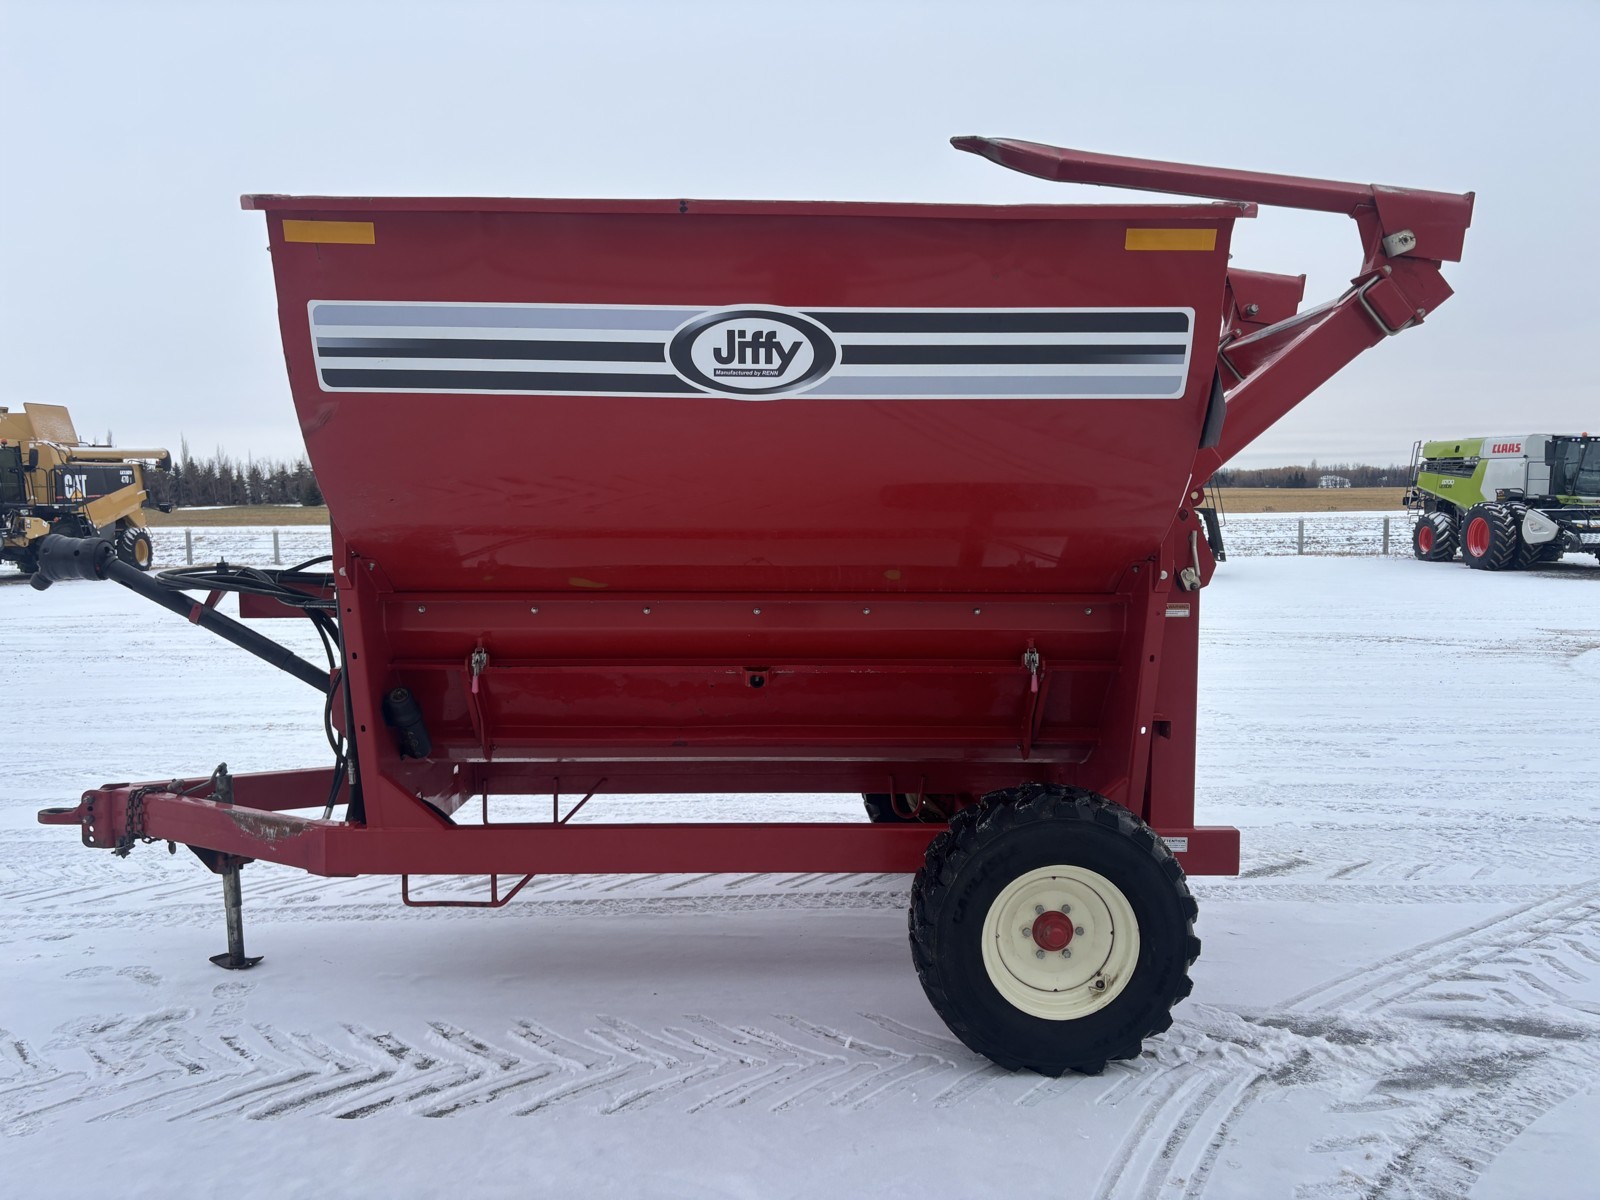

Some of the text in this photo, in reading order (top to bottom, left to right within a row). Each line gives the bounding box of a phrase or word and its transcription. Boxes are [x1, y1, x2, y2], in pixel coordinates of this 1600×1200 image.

[713, 329, 803, 371] Jiffy
[1492, 443, 1521, 454] CLAAS
[64, 474, 87, 499] CAT
